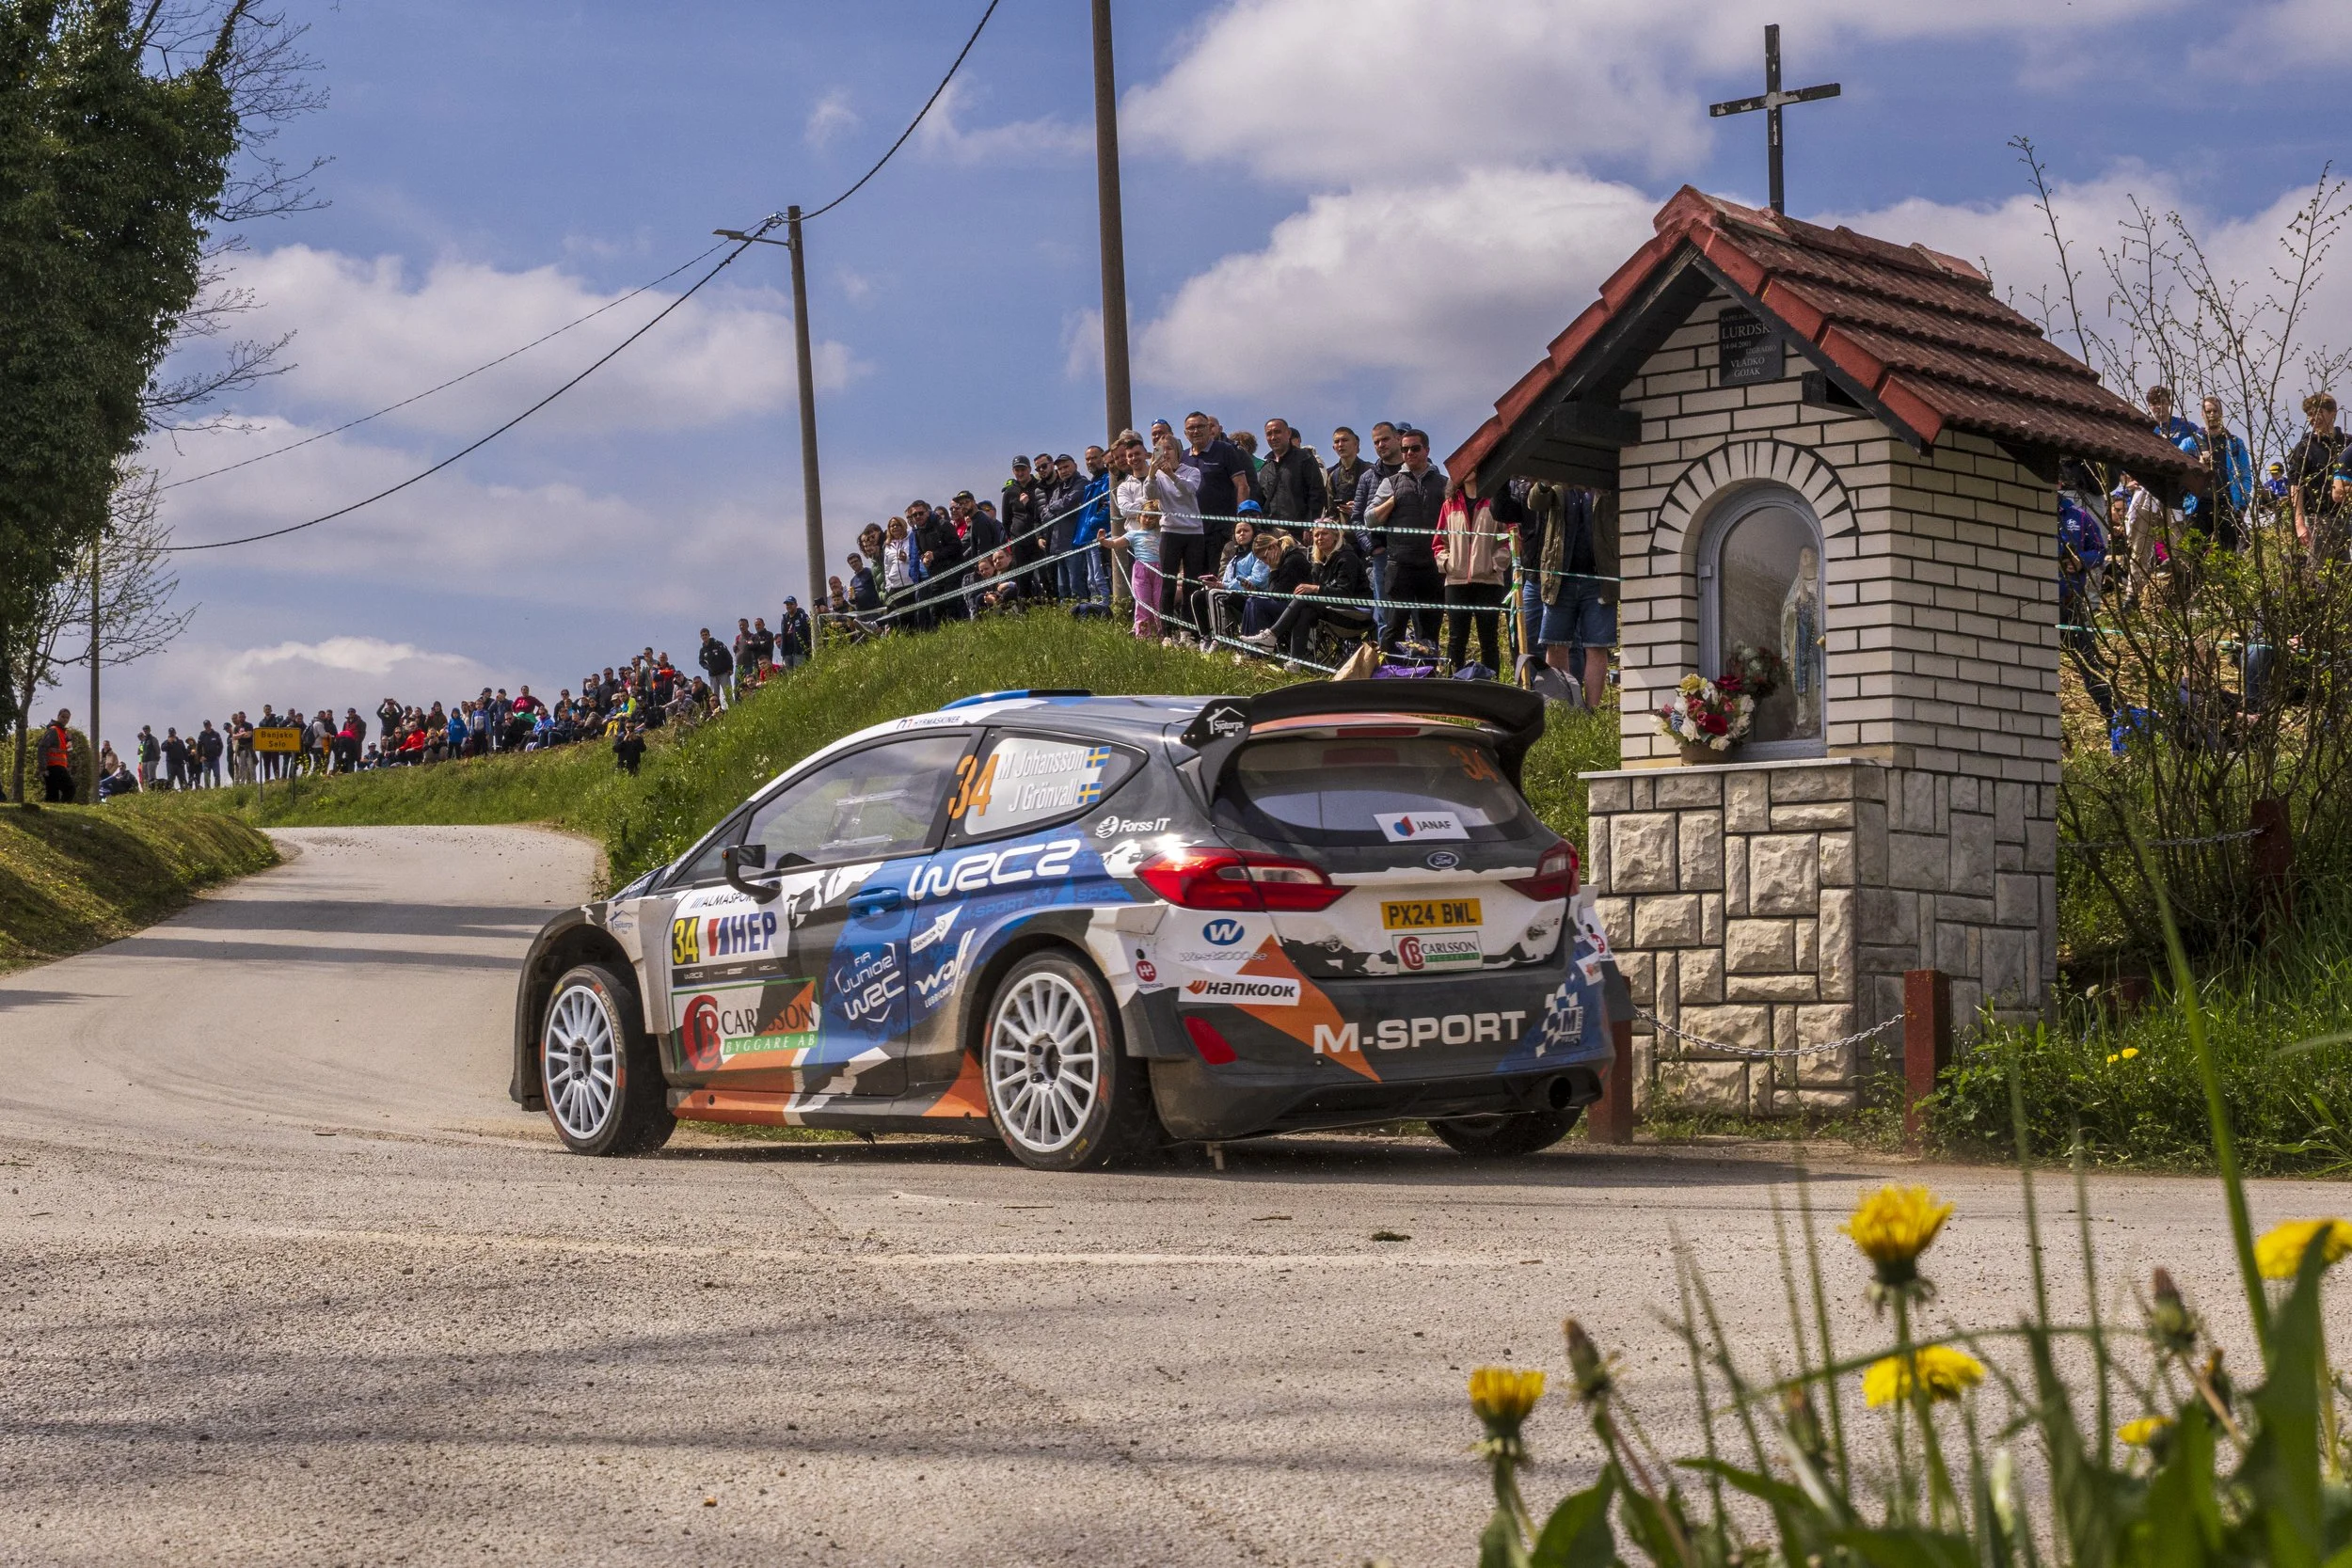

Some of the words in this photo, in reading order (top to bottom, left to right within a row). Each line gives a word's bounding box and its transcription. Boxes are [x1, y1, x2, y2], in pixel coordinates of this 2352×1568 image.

[1722, 323, 1771, 340] LURDSK
[1731, 356, 1765, 368] VLADKO
[1734, 367, 1761, 377] GOJAK
[261, 730, 294, 740] Banjsko
[997, 752, 1014, 780] M
[1015, 749, 1086, 779] Johansson
[1449, 745, 1499, 784] 34
[947, 753, 1000, 819] 34
[1009, 784, 1023, 813] J
[1022, 779, 1080, 812] Grönvall
[1119, 819, 1153, 832] Forss
[1153, 817, 1171, 832] IT
[1417, 820, 1452, 832] JANAF
[907, 838, 1081, 900] WRC2
[700, 892, 756, 908] ALMASPOR
[1388, 905, 1435, 927] PX24
[1441, 902, 1477, 924] BWL
[674, 917, 698, 964] 34
[731, 911, 777, 955] HEP
[854, 951, 871, 968] FIA
[1421, 942, 1477, 954] CARLSSON
[842, 955, 894, 993] JUNIOR
[844, 970, 906, 1022] WRC
[721, 1003, 816, 1036] CARSSON
[1313, 1010, 1526, 1053] M-SPORT
[725, 1037, 790, 1053] BYGGARE
[799, 1034, 816, 1047] AB
